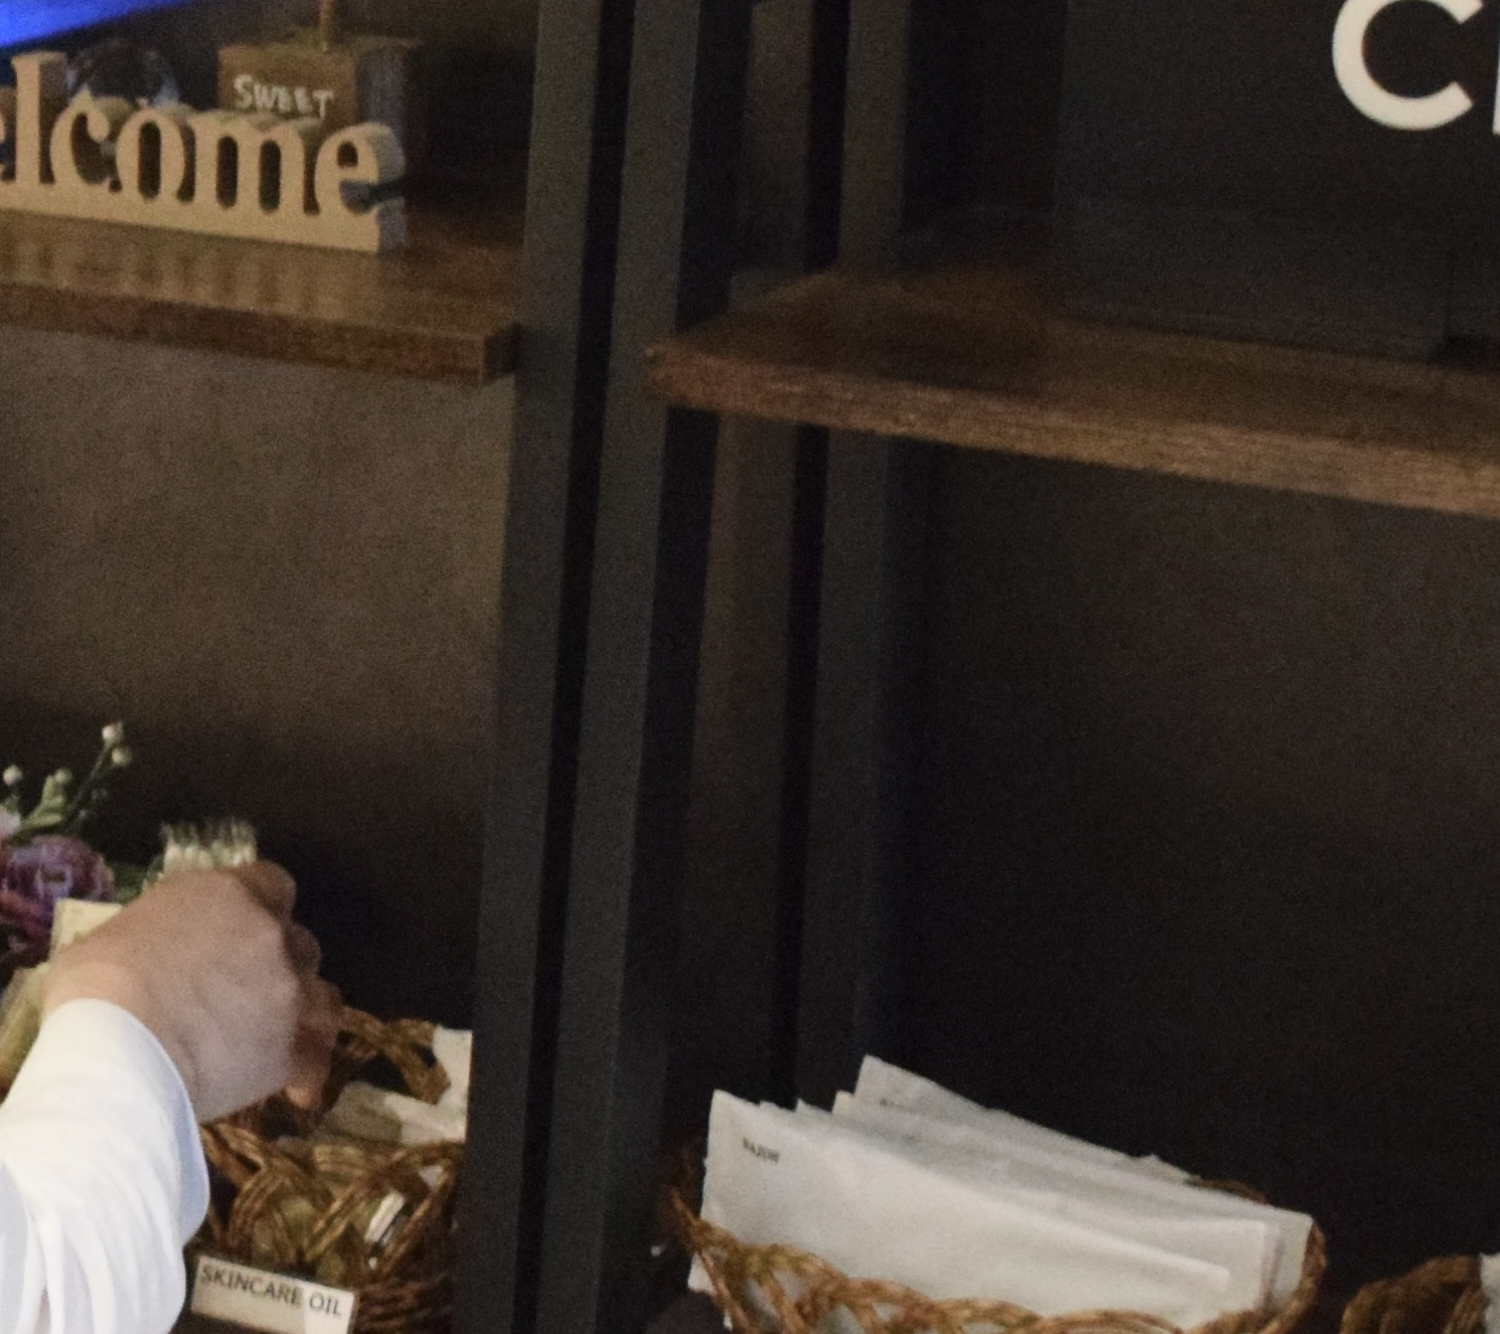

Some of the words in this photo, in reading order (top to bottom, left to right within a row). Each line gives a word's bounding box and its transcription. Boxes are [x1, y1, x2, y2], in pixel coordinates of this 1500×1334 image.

[233, 73, 334, 120] SWEET
[201, 1264, 302, 1305] SKINCARE
[308, 1291, 342, 1316] OIL
